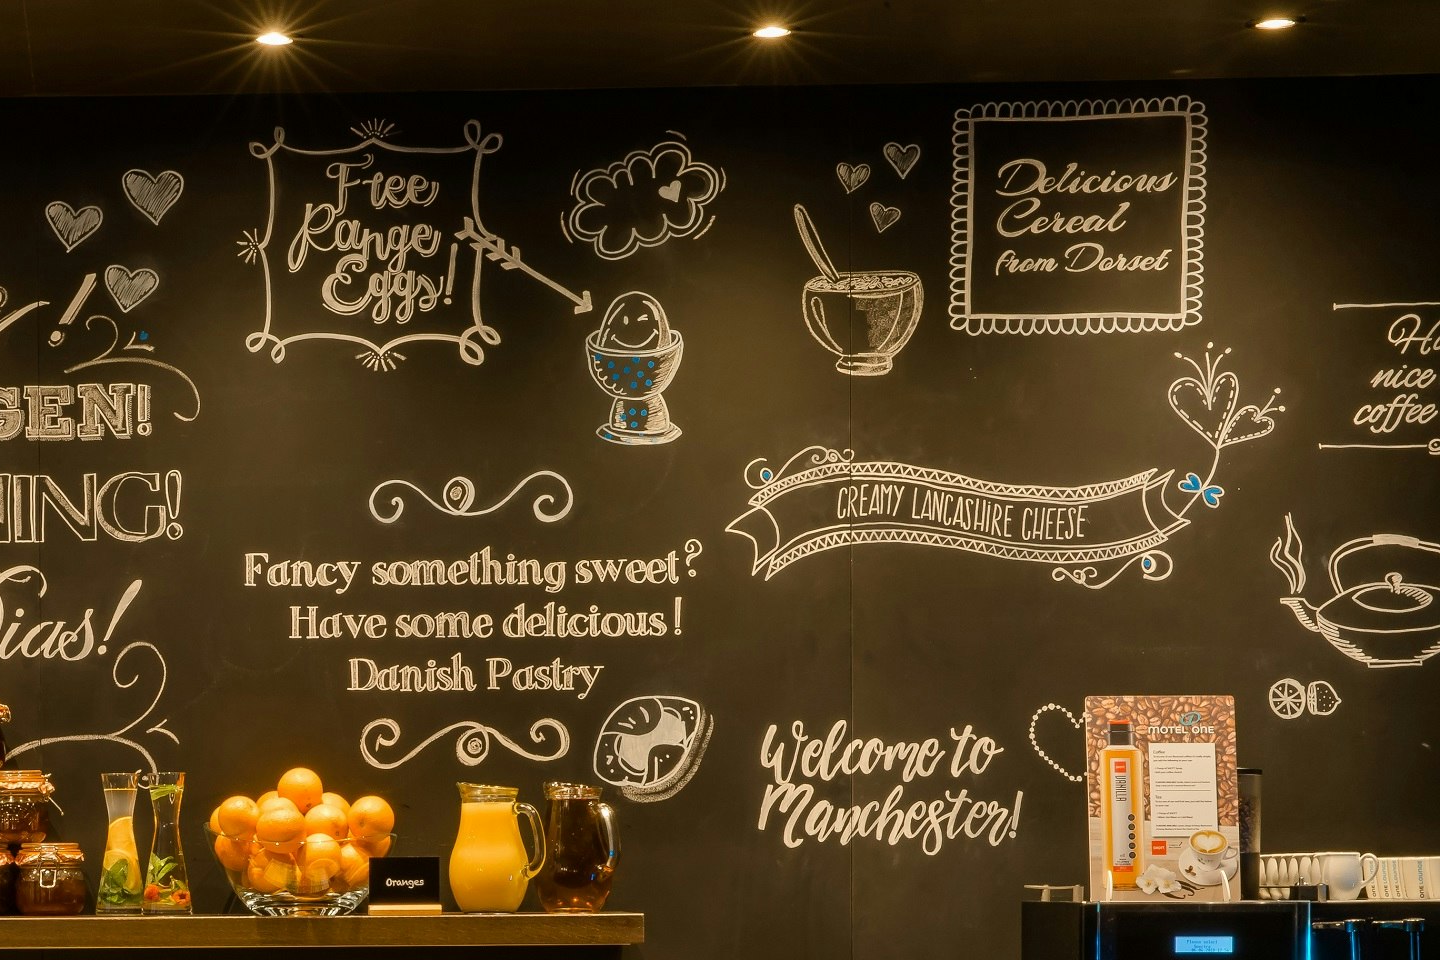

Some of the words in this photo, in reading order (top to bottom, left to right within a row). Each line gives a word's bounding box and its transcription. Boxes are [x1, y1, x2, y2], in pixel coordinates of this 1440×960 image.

[326, 153, 439, 216] Free
[995, 158, 1178, 197] Delicious
[288, 203, 441, 275] Range
[996, 197, 1131, 238] Cereal
[995, 249, 1059, 277] from
[1064, 242, 1173, 273] Dorset
[322, 243, 458, 324] Eggs!
[1370, 364, 1437, 389] nice
[1353, 393, 1439, 434] coffee
[837, 483, 906, 519] CREAMY
[911, 487, 1014, 538] LANCASHIRE
[1021, 504, 1089, 541] CHEESE
[244, 551, 361, 595] Fancy
[371, 546, 568, 592] something
[574, 539, 703, 585] sweet?
[288, 604, 388, 640] Have
[395, 611, 494, 639] some
[503, 596, 684, 639] delicious!
[347, 653, 477, 693] Danish
[485, 657, 605, 700] Pastry
[760, 719, 946, 785] Welcome
[950, 724, 1005, 778] to
[1148, 726, 1189, 735] MOTEL
[1192, 726, 1215, 734] ONE
[1115, 775, 1127, 802] VANILLA
[758, 782, 1024, 856] Manchester!
[385, 877, 425, 889] Oranges
